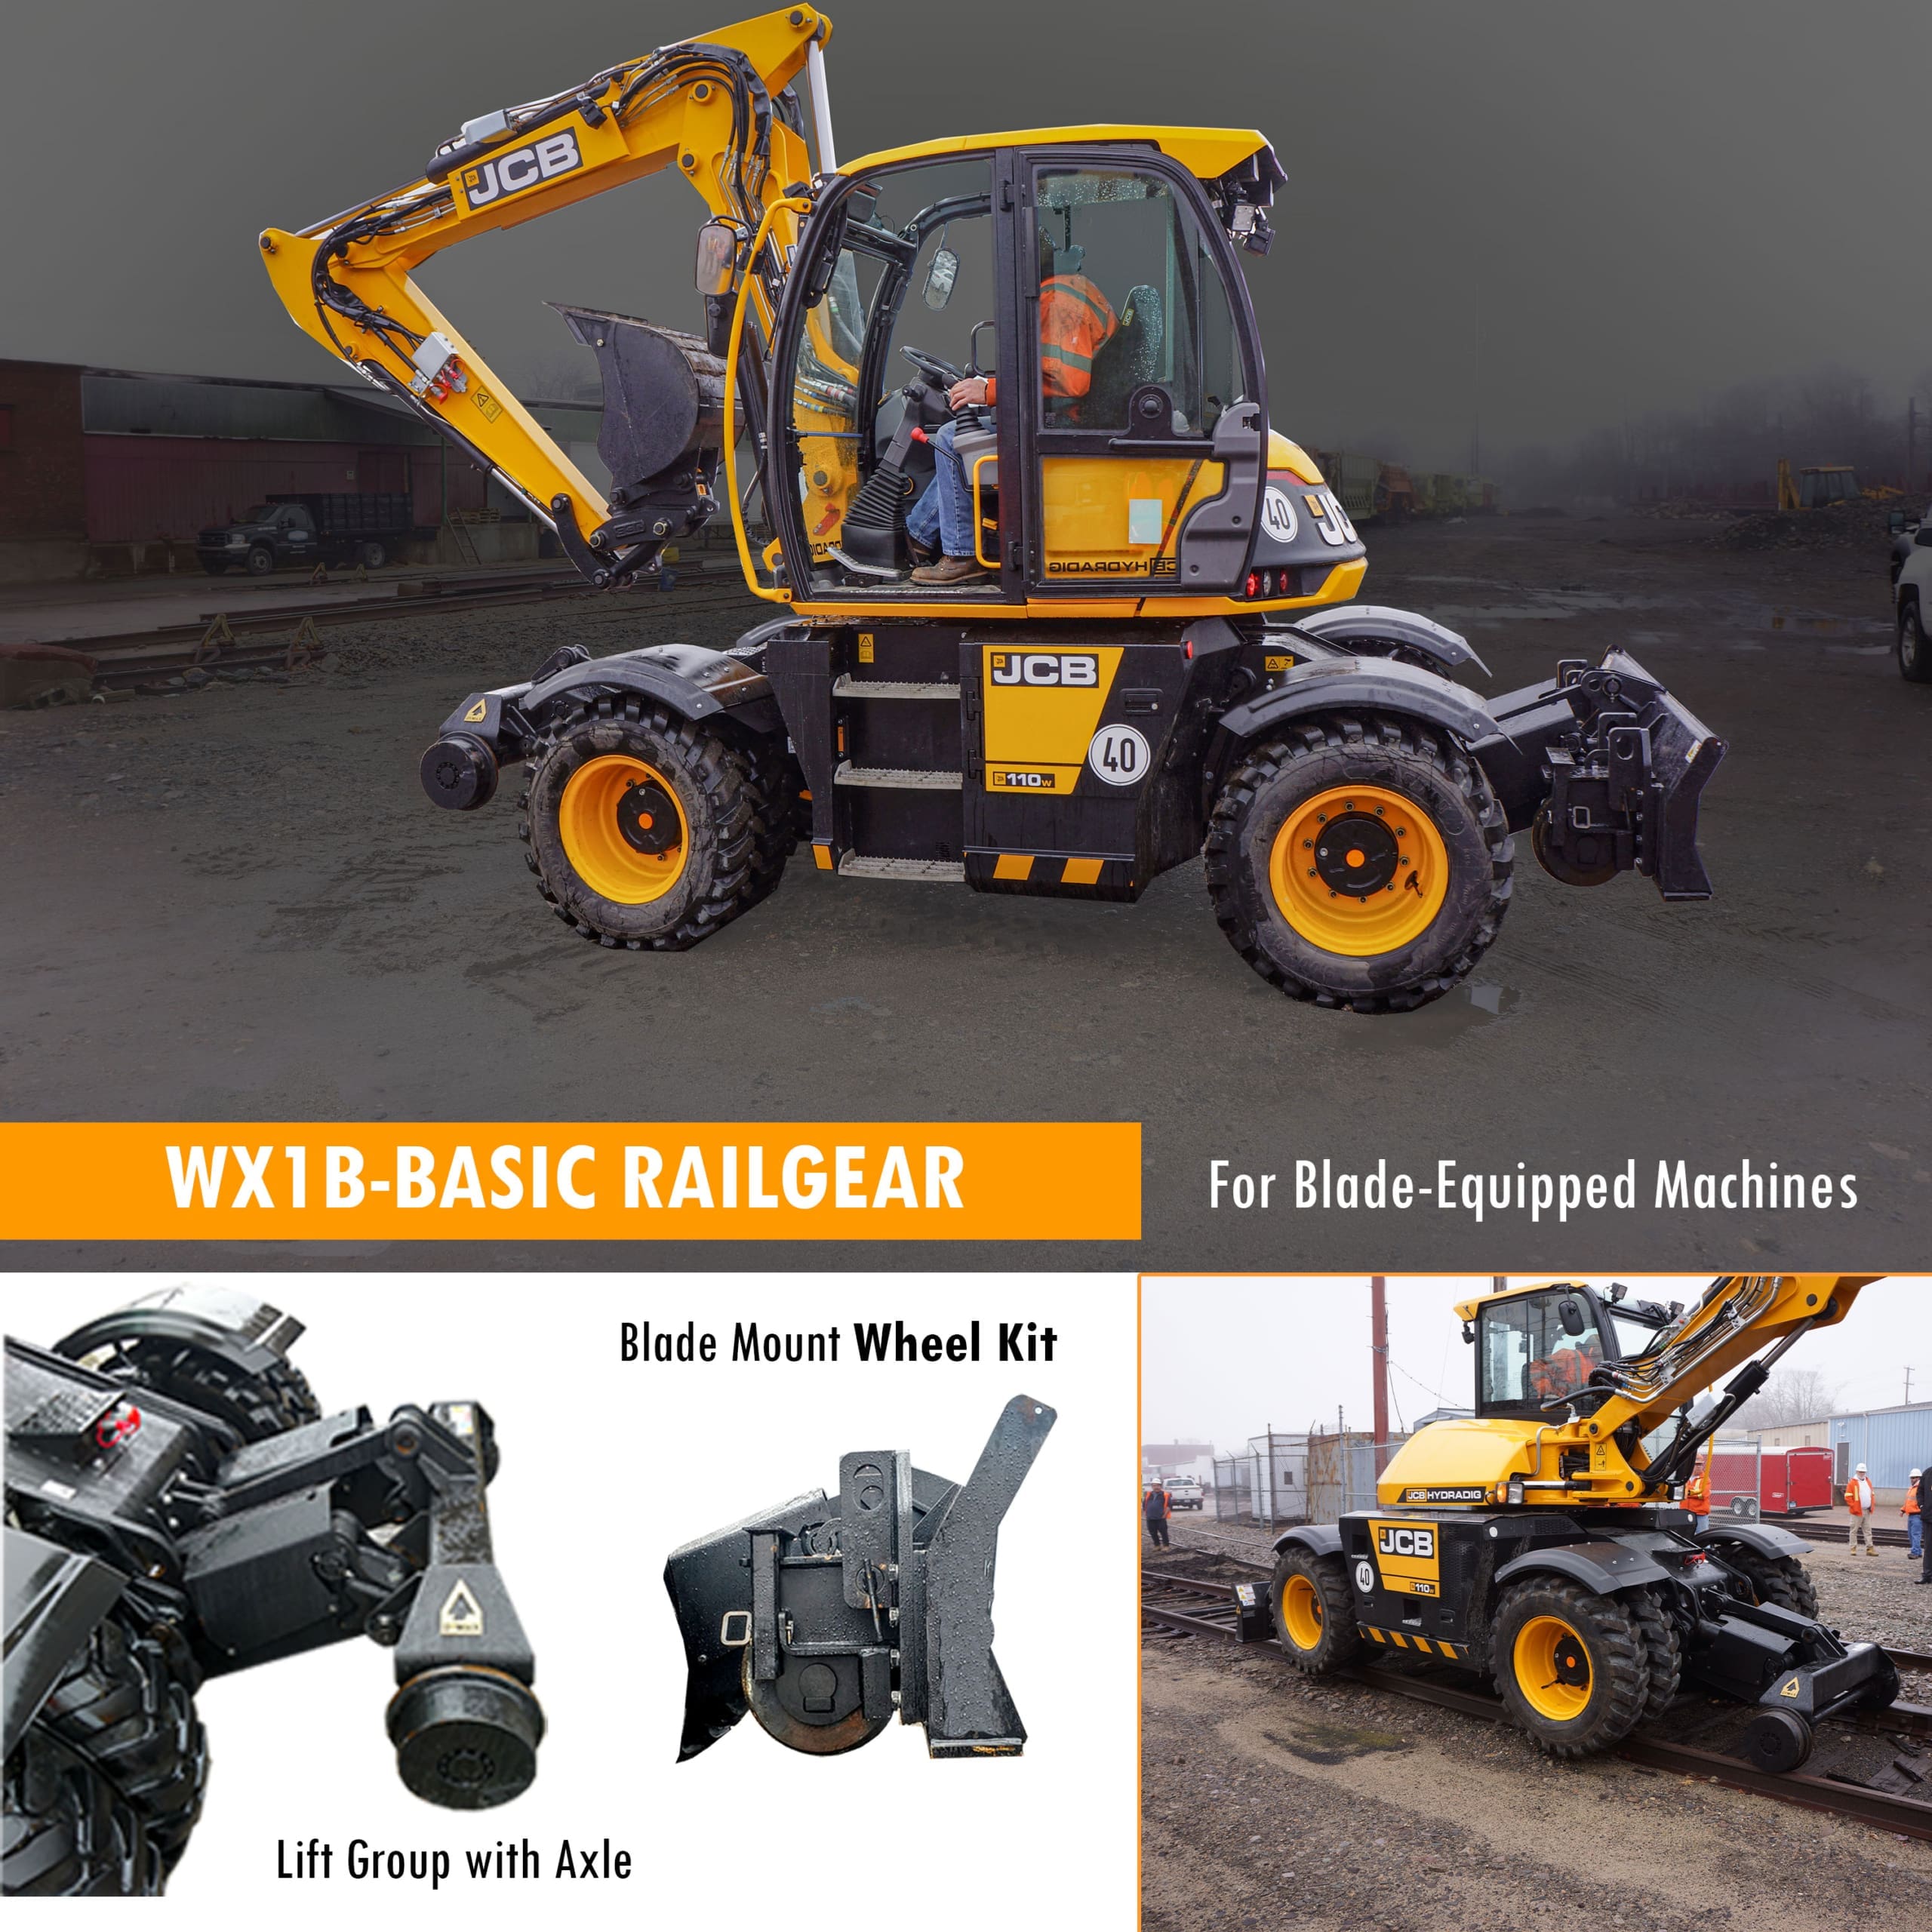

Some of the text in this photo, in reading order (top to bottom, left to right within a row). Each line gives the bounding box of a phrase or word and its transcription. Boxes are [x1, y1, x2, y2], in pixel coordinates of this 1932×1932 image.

[469, 134, 579, 205] JCB
[1266, 498, 1291, 530] 40
[993, 655, 1097, 685] JCB
[1103, 737, 1136, 773] 40
[1407, 1491, 1481, 1500] JCB HYDRADIG
[1380, 1529, 1433, 1556] JCB
[1360, 1567, 1370, 1586] 40
